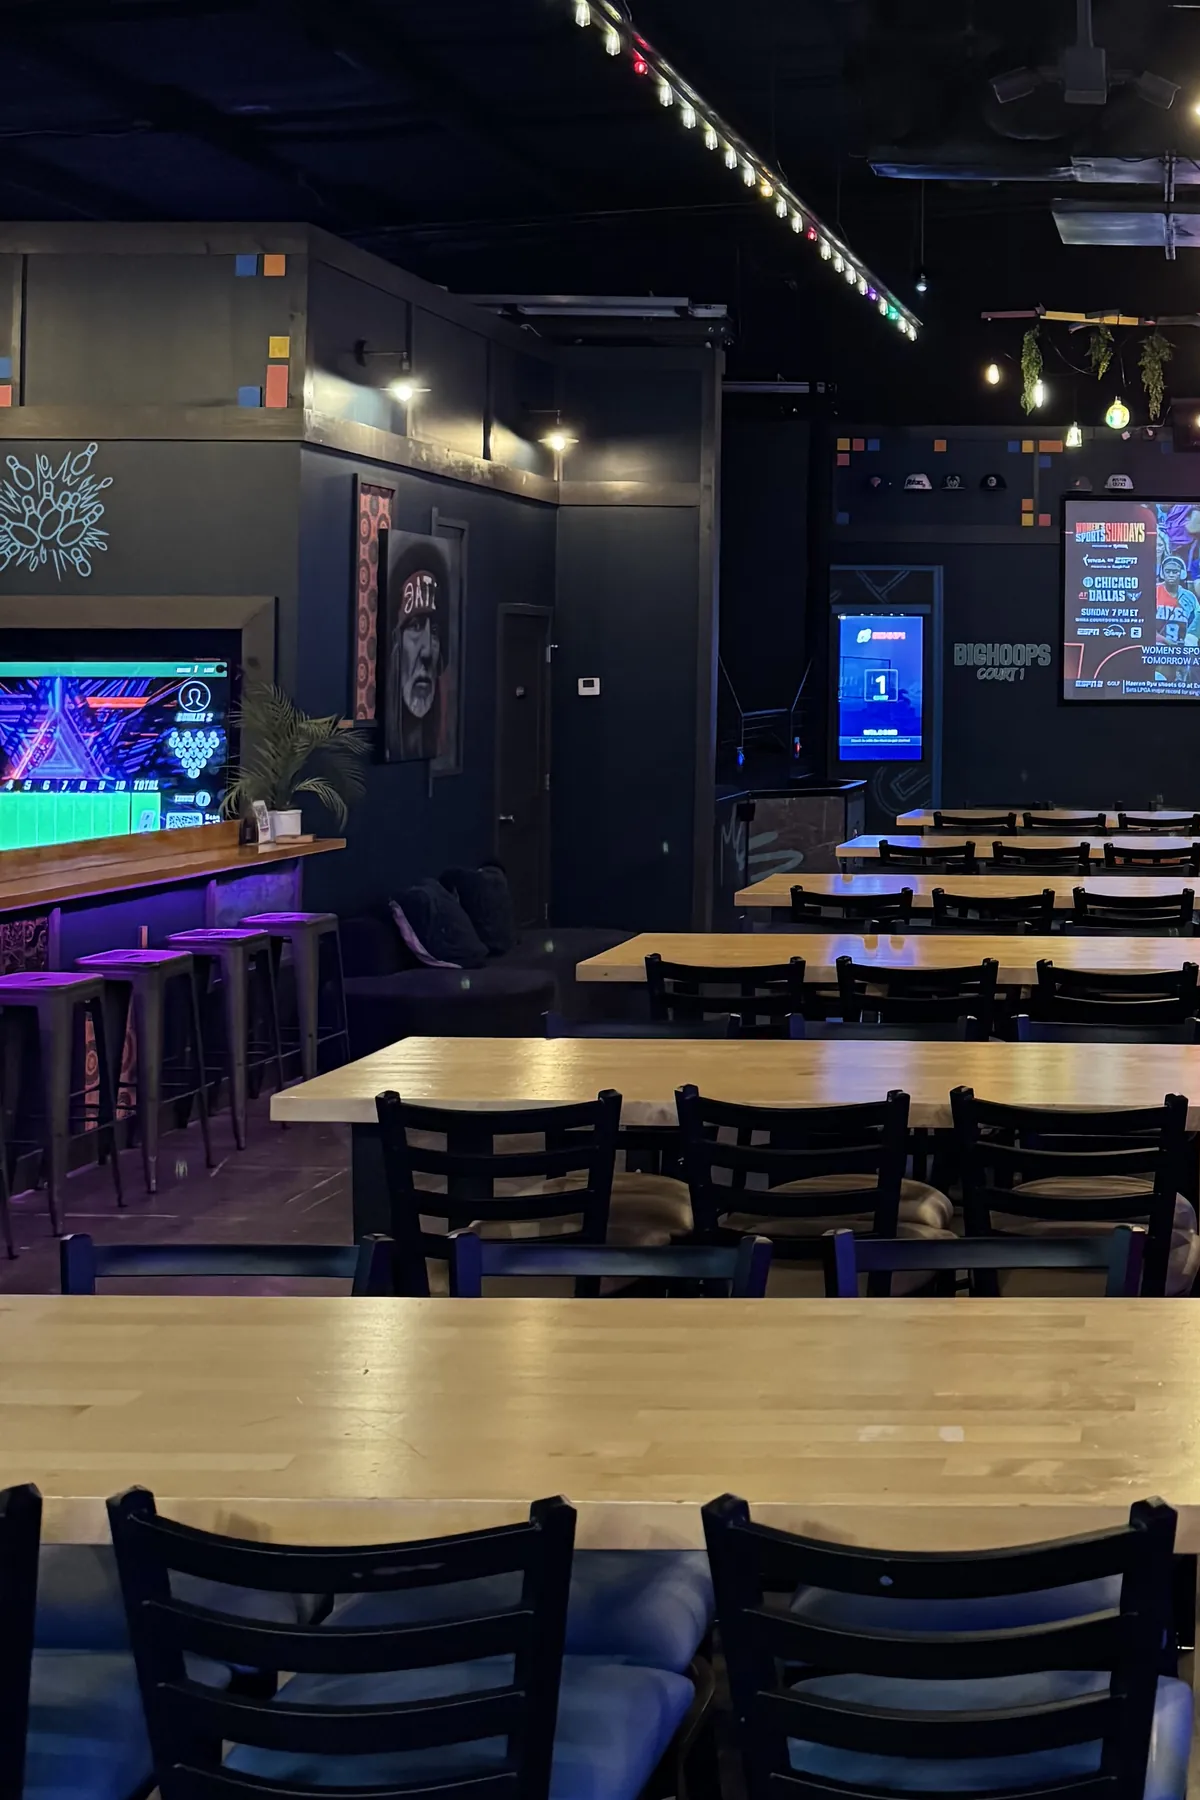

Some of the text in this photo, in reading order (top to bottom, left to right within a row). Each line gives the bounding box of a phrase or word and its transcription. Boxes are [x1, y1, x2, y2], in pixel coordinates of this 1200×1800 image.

[1076, 529, 1105, 543] SPORTS
[1106, 522, 1145, 543] SUNDAYS
[1094, 577, 1138, 589] CHICAGO
[1089, 590, 1125, 601] DALLAS
[1081, 608, 1110, 616] SUNDAY
[953, 643, 1052, 666] BIGHOOPS
[1142, 646, 1182, 654] WOMEN'S
[1141, 656, 1192, 664] TOMORROW
[977, 667, 1025, 681] COURT 1
[875, 675, 886, 694] 1
[205, 713, 213, 722] 2
[5, 780, 14, 790] 4
[23, 780, 32, 790] 5
[42, 780, 50, 790] 6
[61, 780, 69, 790] 7
[97, 780, 106, 790] 9
[115, 780, 126, 791] 10
[133, 779, 160, 791] TOTAL
